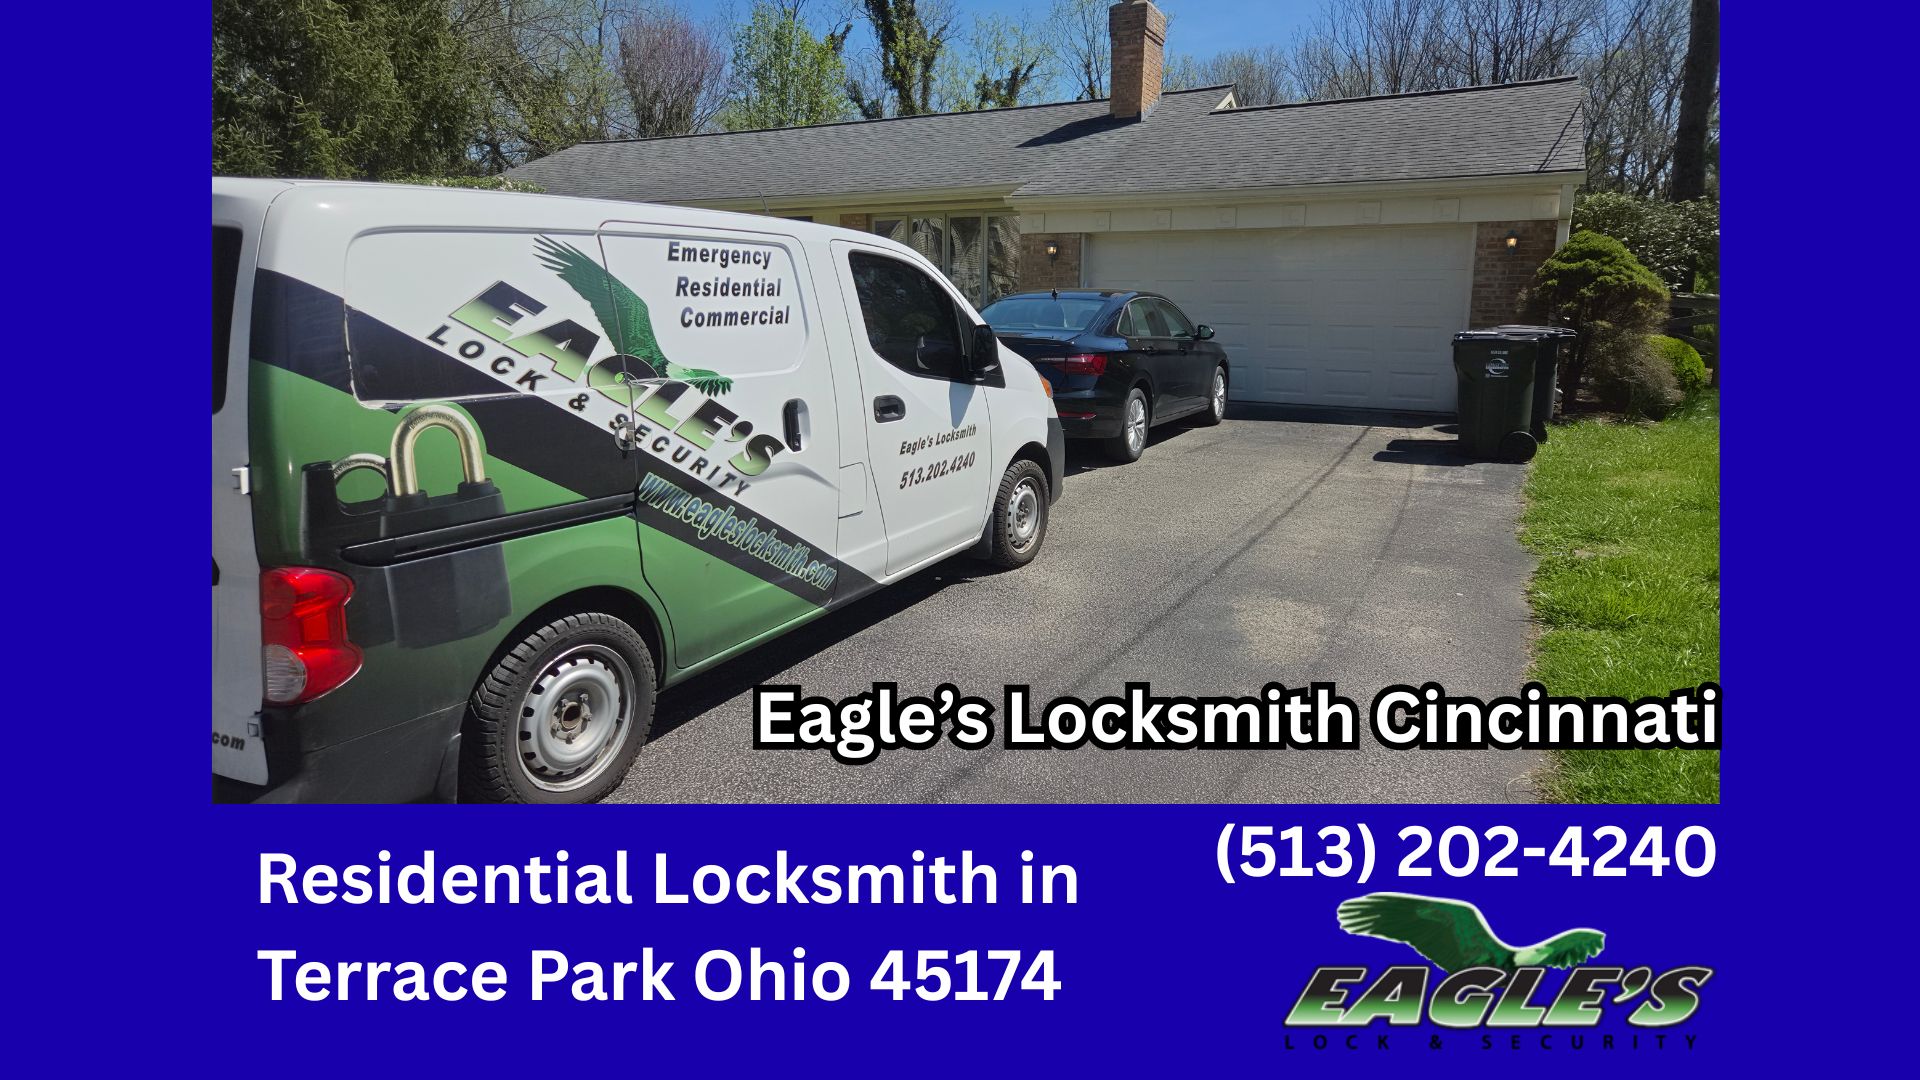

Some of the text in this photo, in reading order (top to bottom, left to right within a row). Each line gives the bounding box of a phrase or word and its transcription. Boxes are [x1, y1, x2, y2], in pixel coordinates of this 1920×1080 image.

[667, 241, 772, 270] Emergency
[675, 276, 782, 297] Residential
[680, 305, 790, 328] Commercial
[449, 280, 786, 477] EAGLE'S
[427, 323, 752, 497] LOCK & SECURITY
[899, 423, 977, 456] Eagle's Locksmith
[899, 451, 976, 490] 513.202.4240
[638, 471, 838, 591] www.eagleslocksmith.com
